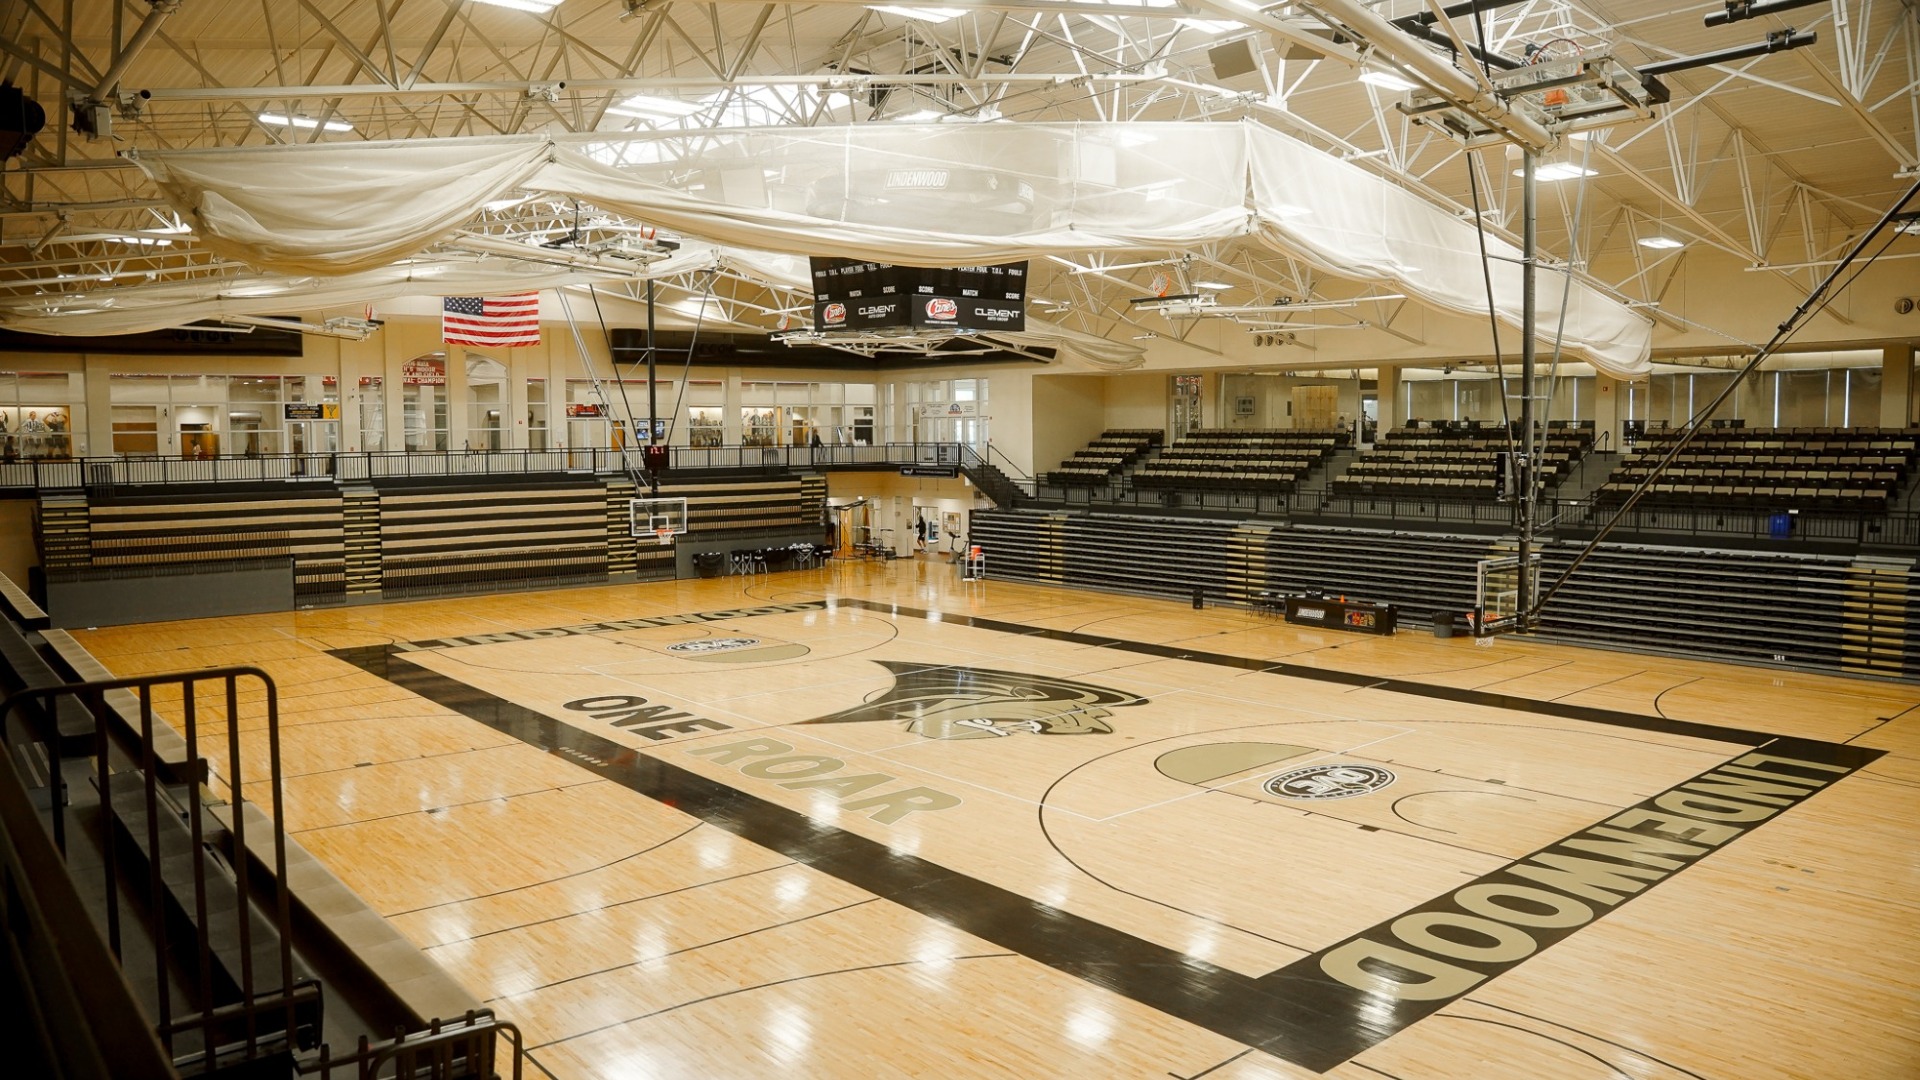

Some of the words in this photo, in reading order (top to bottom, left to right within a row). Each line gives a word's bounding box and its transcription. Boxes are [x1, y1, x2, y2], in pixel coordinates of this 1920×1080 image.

[887, 171, 947, 187] LINDENWOOD
[1008, 268, 1022, 276] FOULS
[883, 286, 896, 294] SCORE
[1006, 292, 1020, 300] SCORE
[858, 304, 896, 315] CLEMENT
[926, 298, 957, 317] Cane's
[975, 308, 1020, 318] CLEMENT
[395, 601, 826, 652] LINDENWOOD
[563, 695, 734, 741] ONE
[685, 737, 962, 826] ROAR
[1320, 753, 1851, 1001] LINDENWOOD
